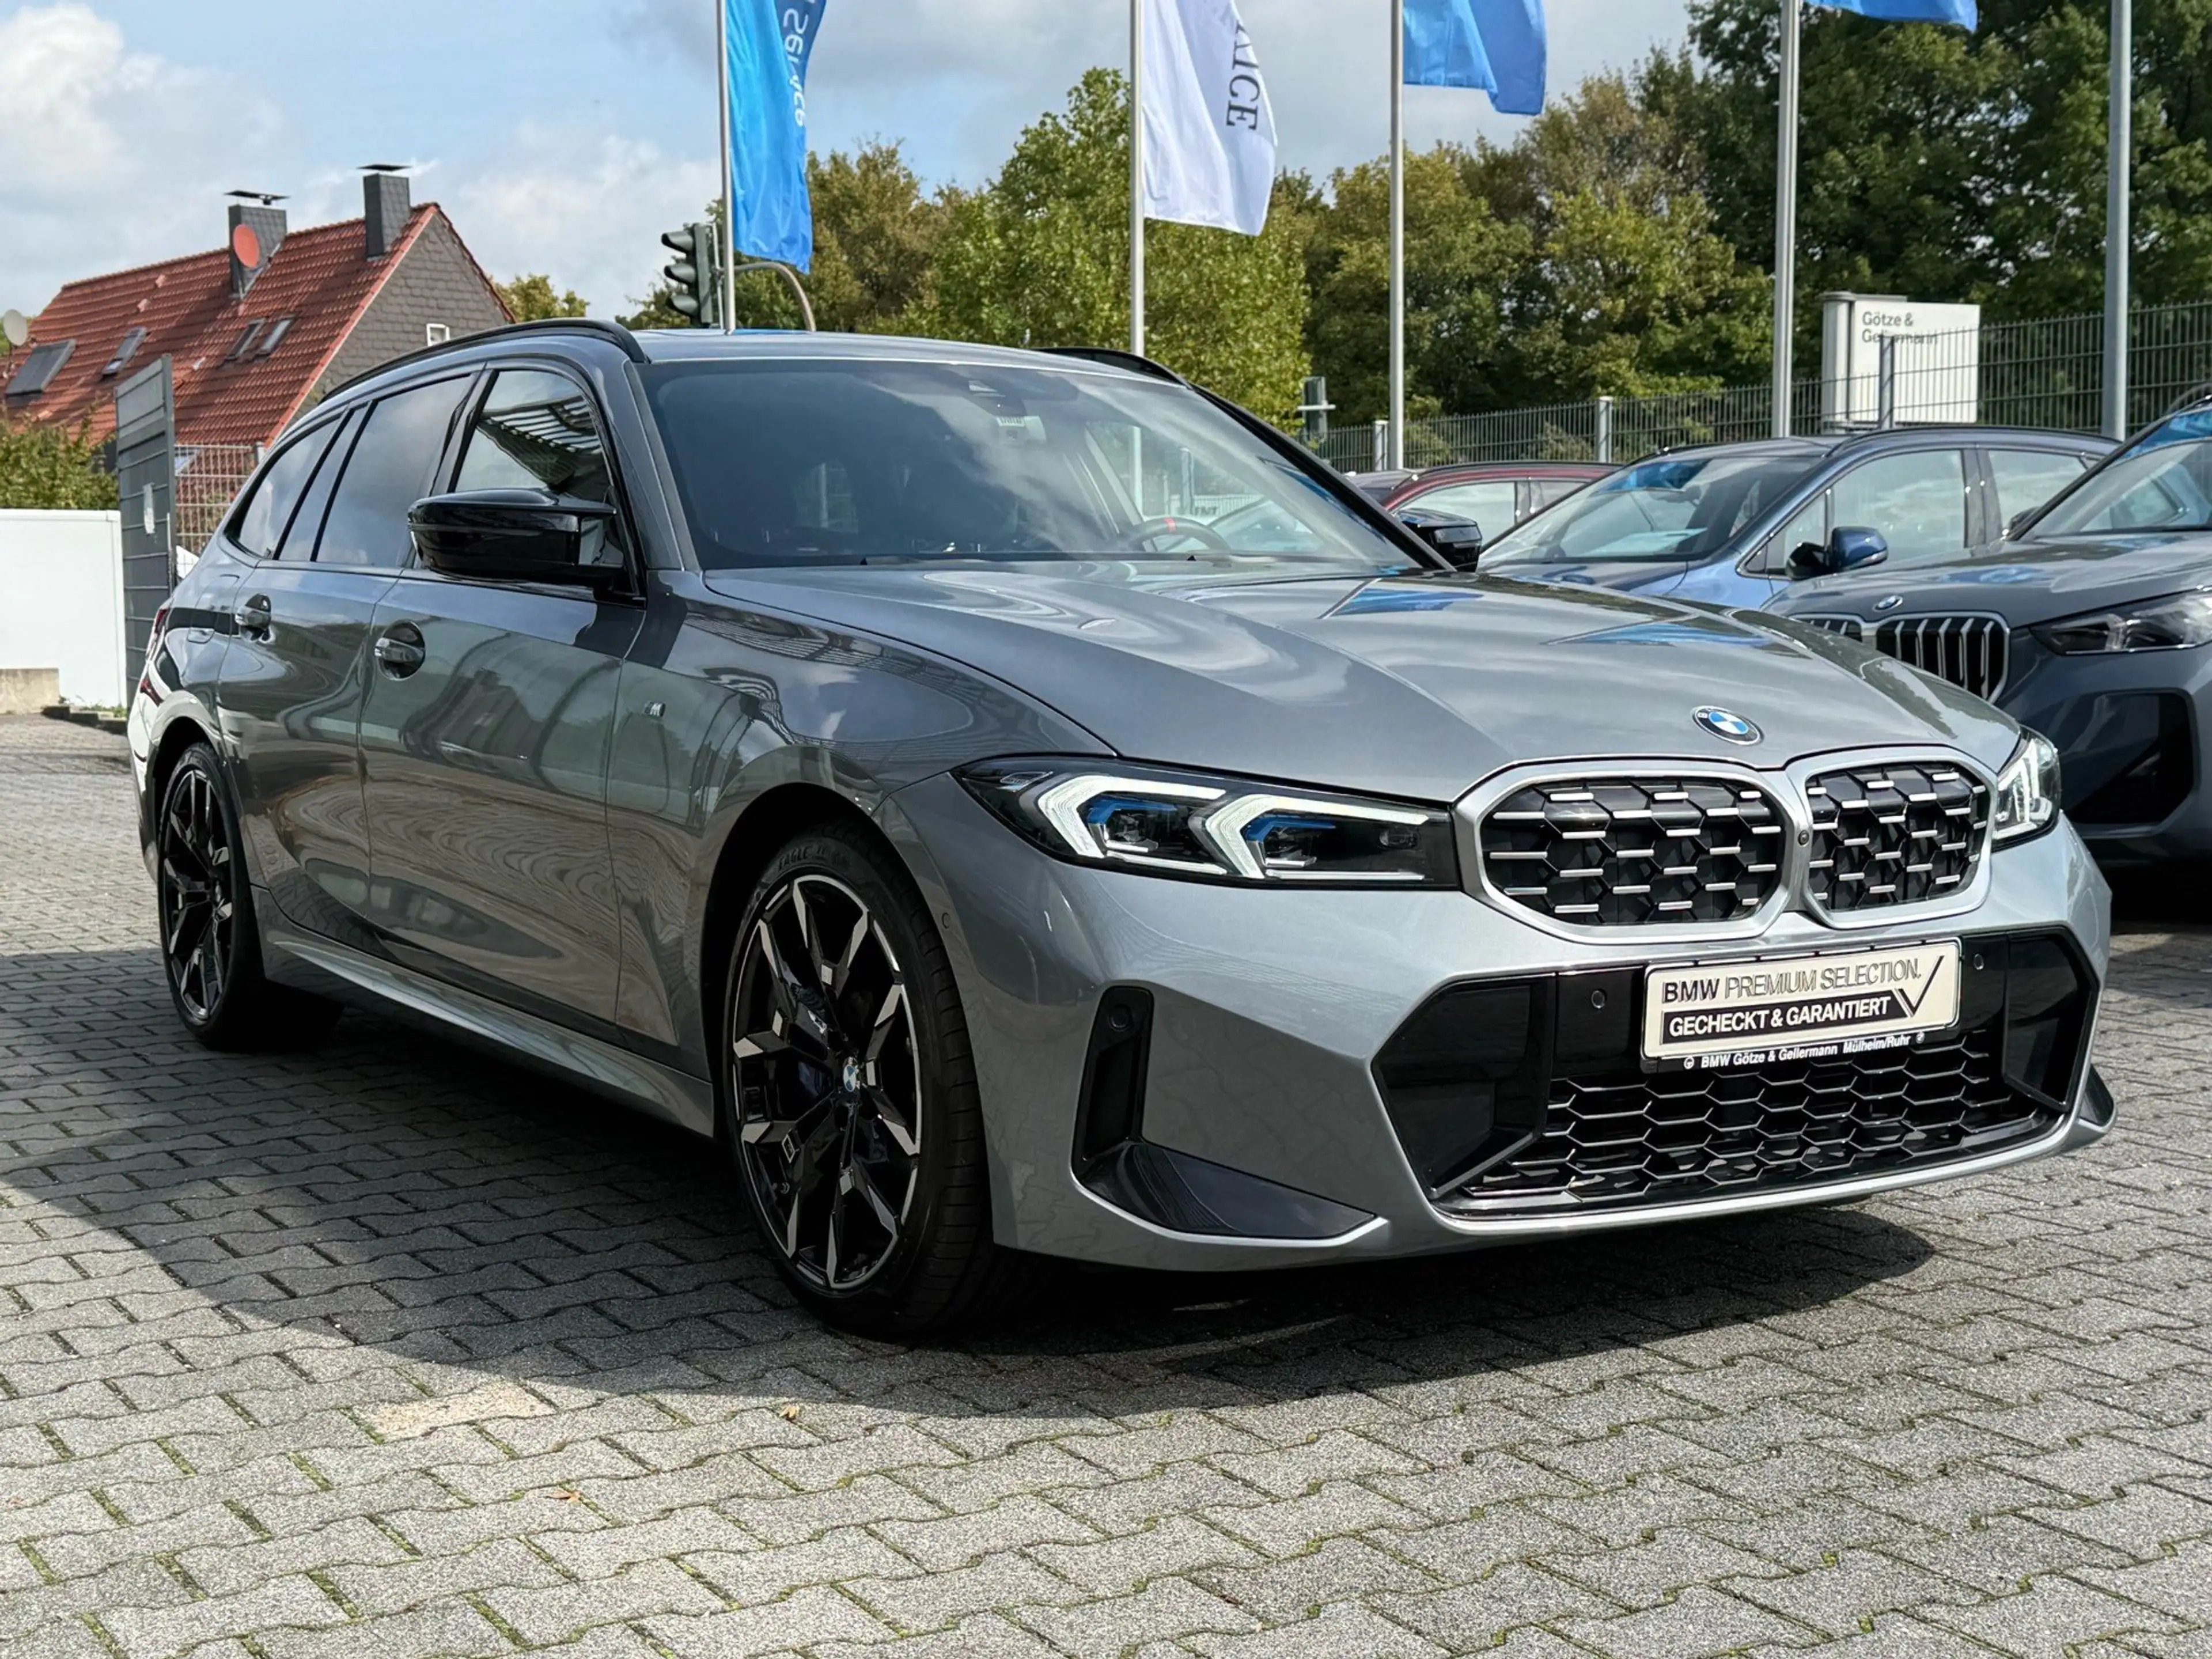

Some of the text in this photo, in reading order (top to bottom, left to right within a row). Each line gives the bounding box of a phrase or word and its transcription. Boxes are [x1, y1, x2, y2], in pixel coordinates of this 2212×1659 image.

[1862, 311, 1914, 327] Götze &
[1662, 978, 1720, 1004] BMW
[1725, 970, 1816, 999] PREMIUM
[1669, 997, 1892, 1037] GECHECKT & GARANTIERT
[1701, 1034, 1911, 1068] BMW Götze & Gellermann Mülheim/Ruhr
